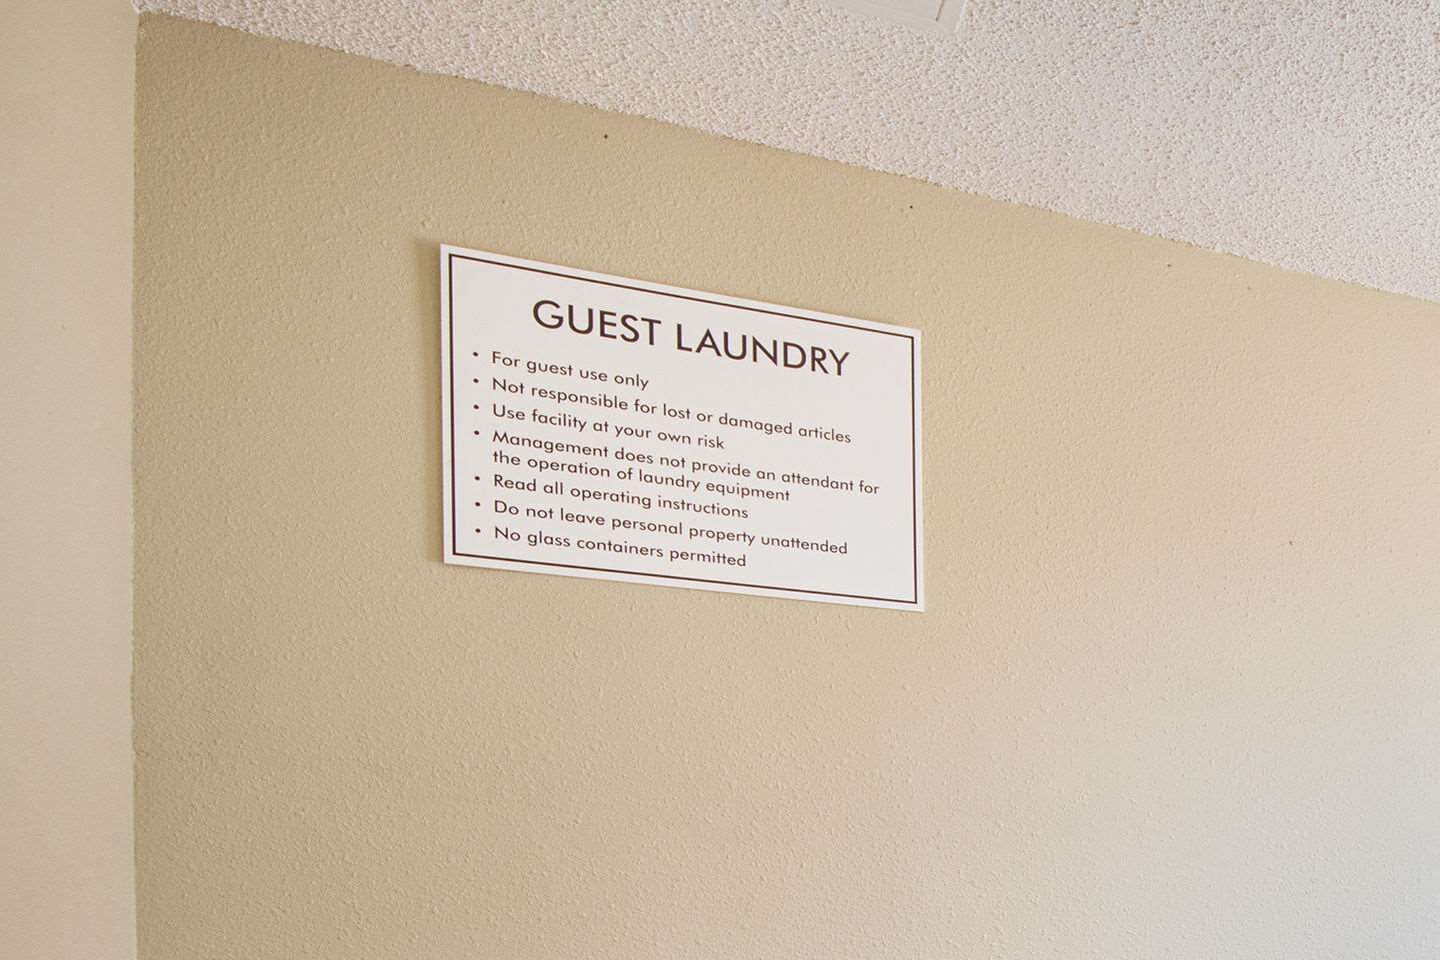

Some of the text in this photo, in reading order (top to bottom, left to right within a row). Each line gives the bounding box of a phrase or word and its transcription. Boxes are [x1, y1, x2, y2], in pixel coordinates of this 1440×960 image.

[533, 300, 850, 376] GUEST LAUNDRY
[492, 351, 649, 391] For guest use only
[493, 377, 851, 443] Not responsible for lost or damaged articles
[493, 403, 724, 449] Use facility at your own risk
[492, 430, 879, 494] Management does not provide an attendant for
[493, 450, 790, 501] the operation of laundry equipment
[494, 474, 748, 519] Read all operating instructions
[494, 500, 847, 554] Do not leave personal property unattended
[495, 526, 746, 567] No glass containers permitted
